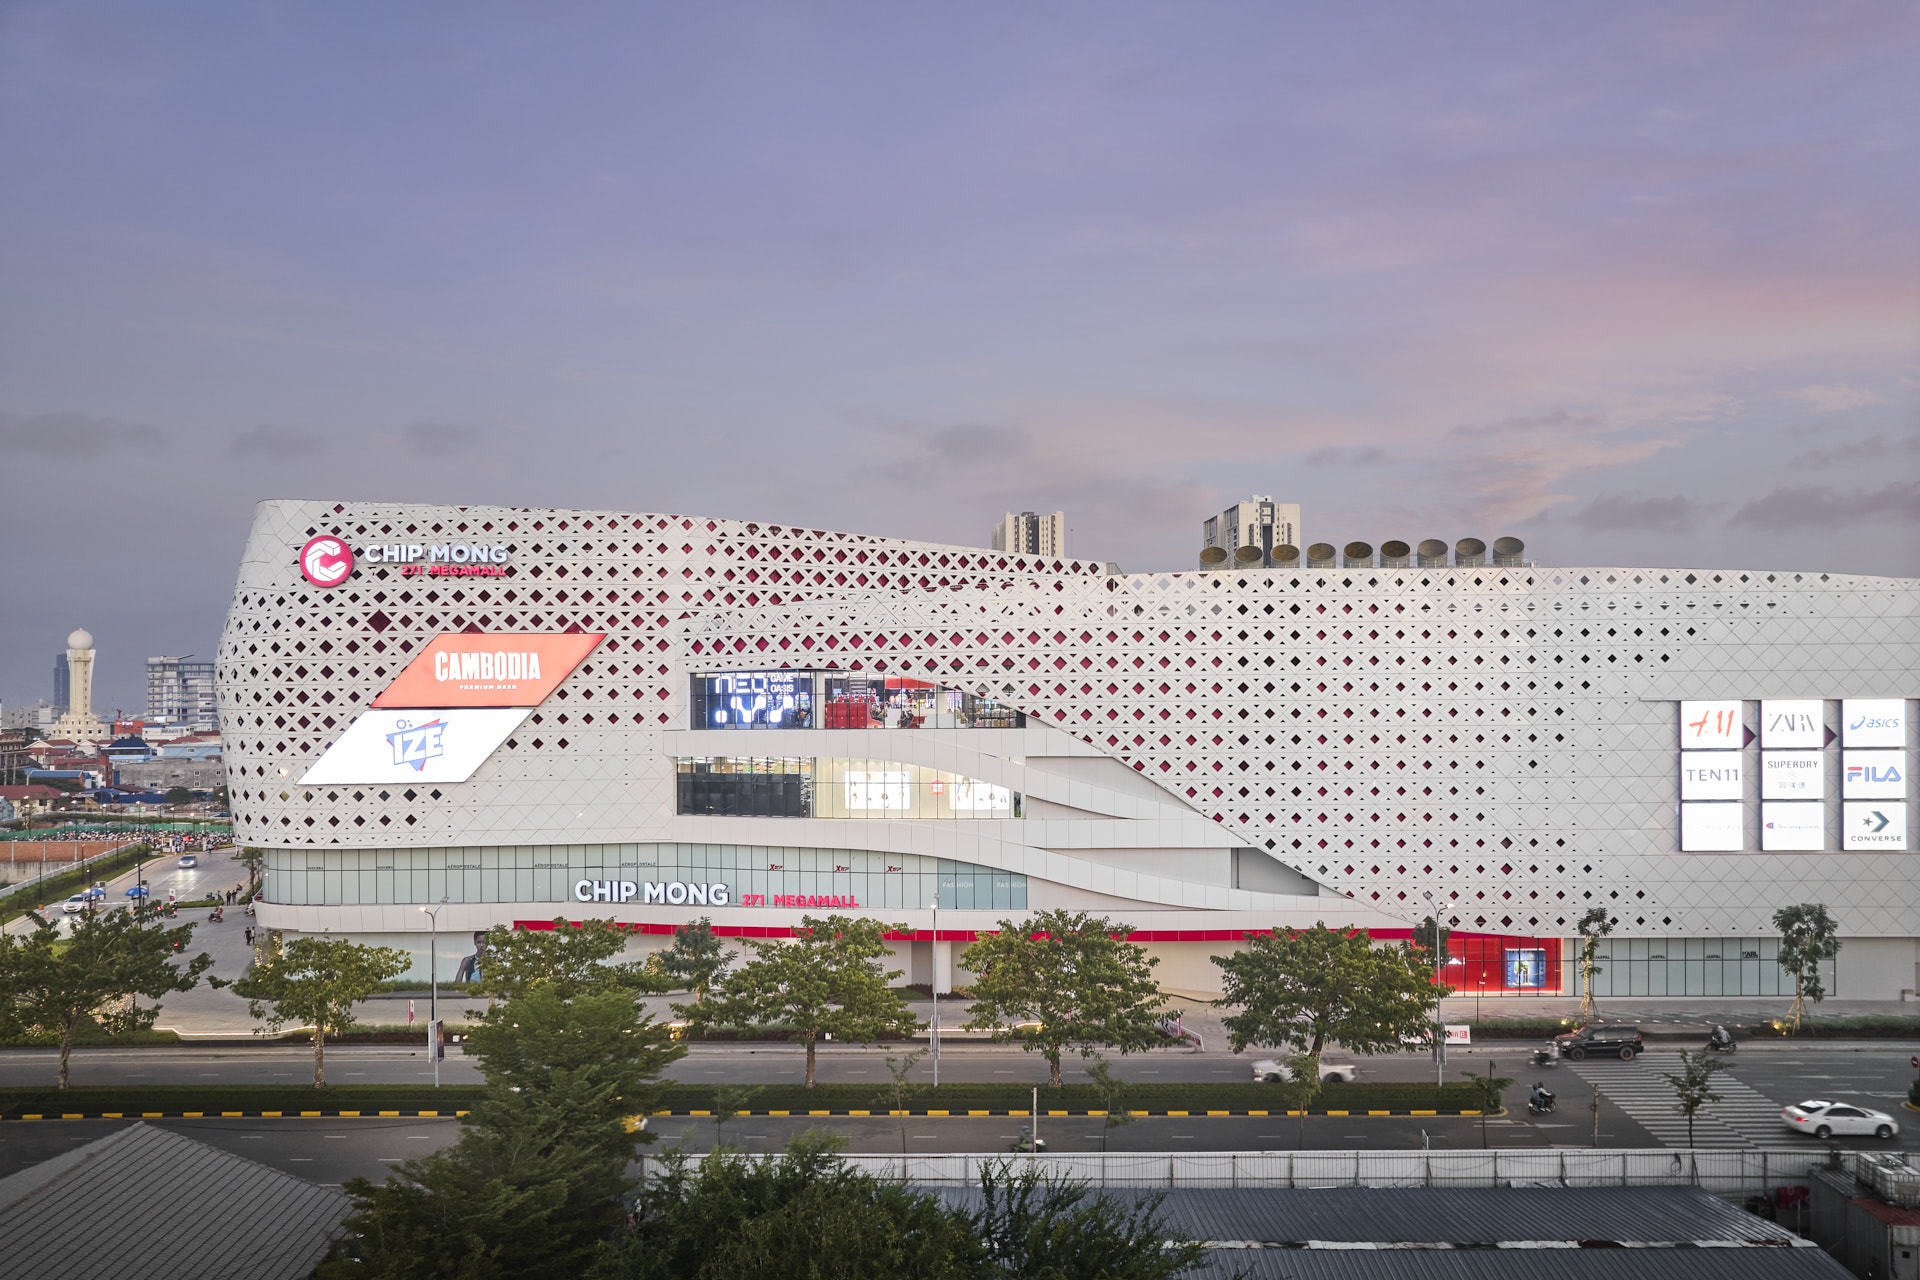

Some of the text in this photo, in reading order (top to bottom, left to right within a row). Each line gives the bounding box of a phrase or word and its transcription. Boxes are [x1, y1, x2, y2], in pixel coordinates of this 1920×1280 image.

[364, 544, 508, 563] CHIP MONG
[401, 565, 507, 577] 271 MEGAMALL
[434, 650, 541, 682] CAMBODIA
[770, 674, 794, 683] GAME
[770, 684, 794, 693] OASIS
[1866, 718, 1899, 728] asics
[393, 726, 443, 765] IZE
[1767, 760, 1818, 769] SUPERDRY
[1686, 768, 1739, 782] TEN11
[1847, 766, 1902, 782] FILA
[942, 881, 974, 889] FASHION
[574, 879, 730, 906] CHIP MONG
[741, 894, 860, 909] 271 MEGAMALL
